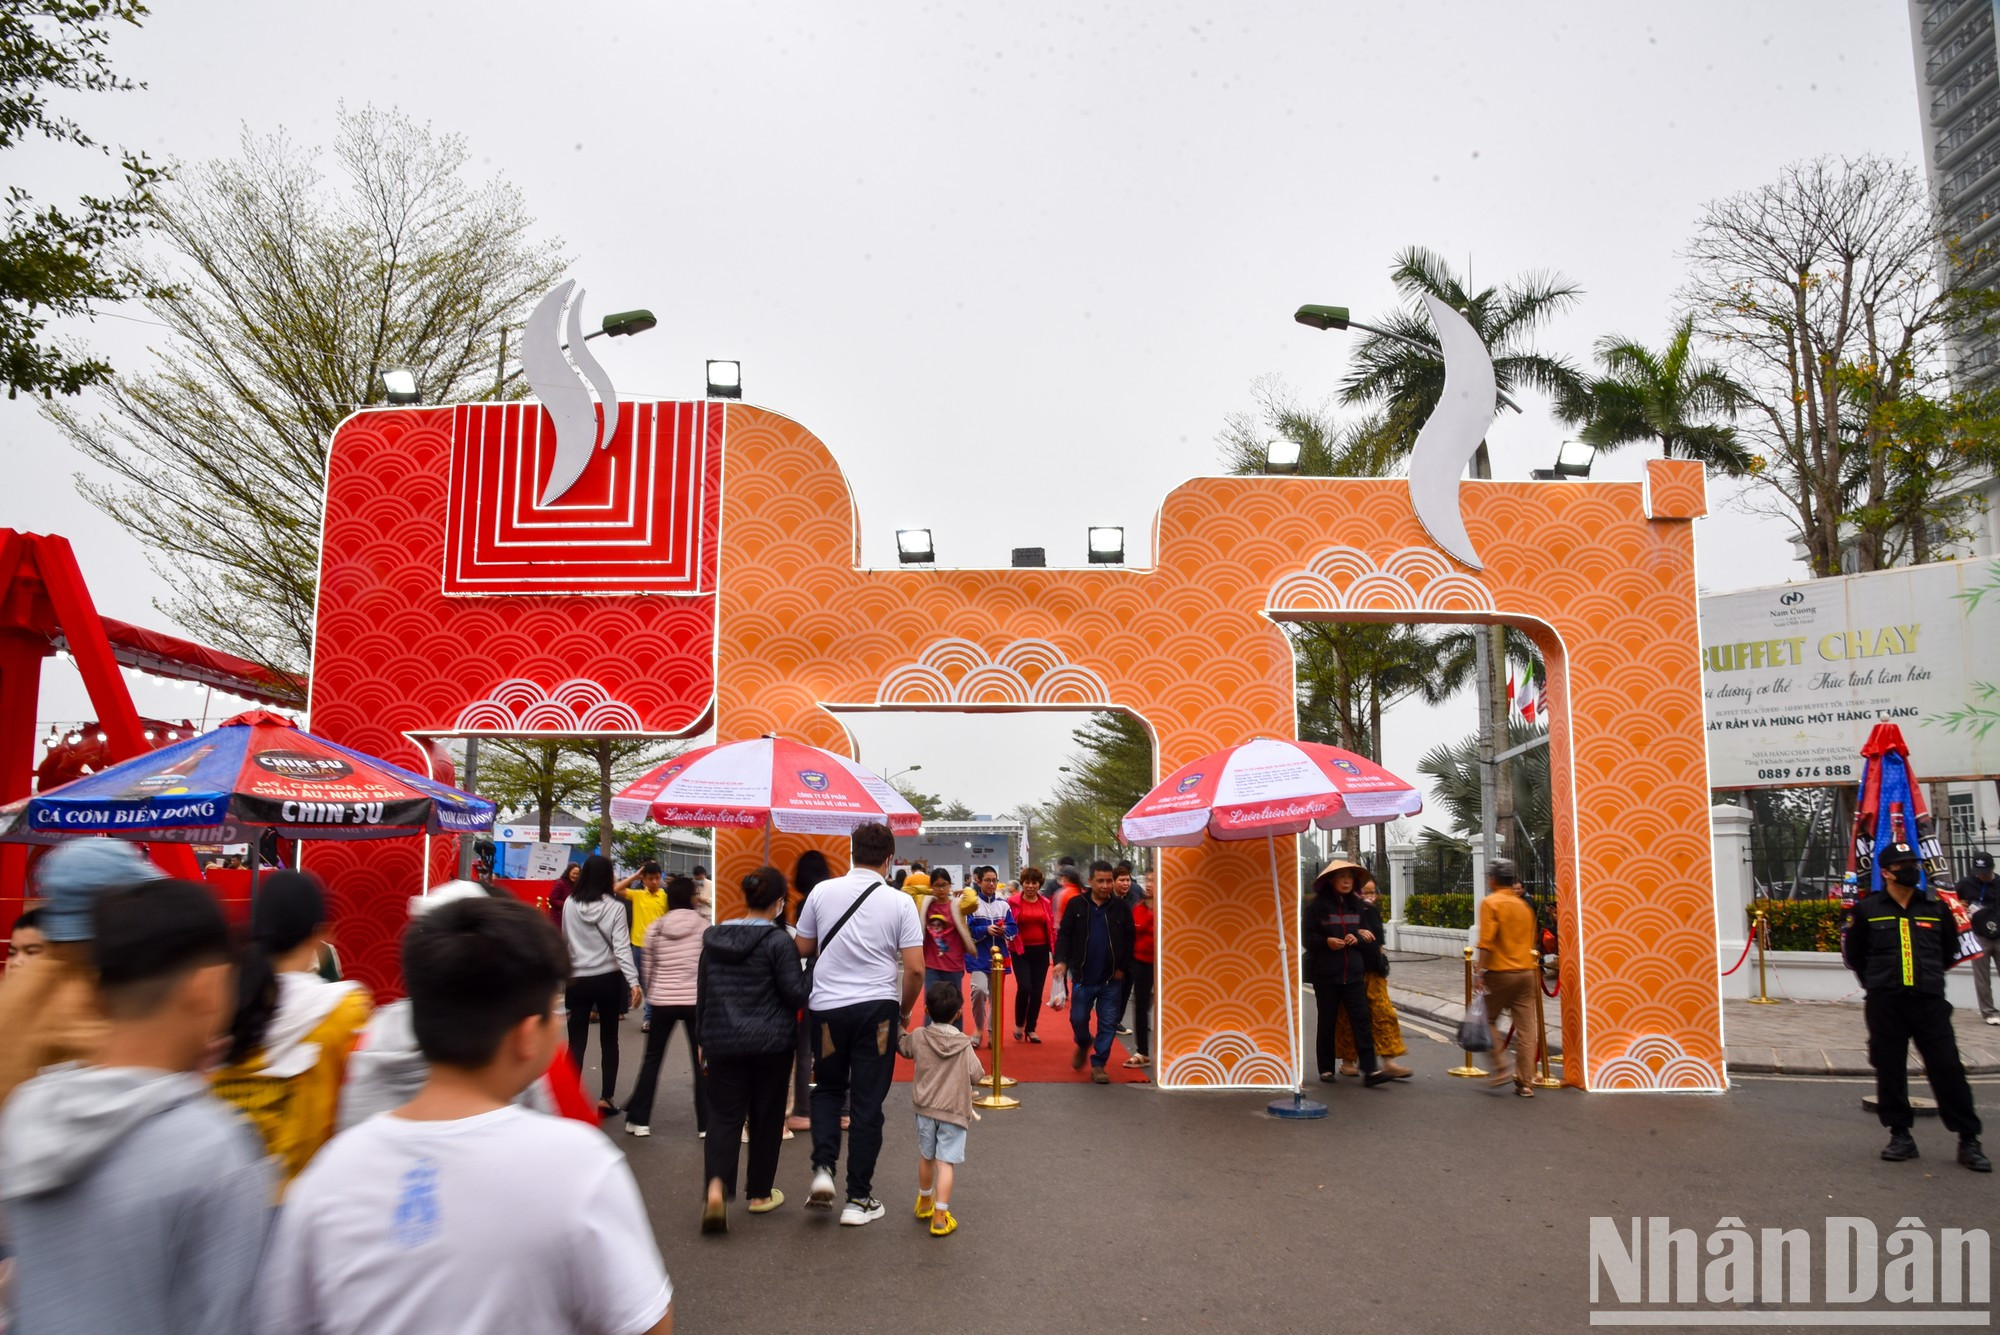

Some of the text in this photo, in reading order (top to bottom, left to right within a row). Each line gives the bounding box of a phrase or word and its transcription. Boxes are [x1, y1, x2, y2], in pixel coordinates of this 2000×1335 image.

[1818, 623, 1922, 662] CHAY
[1837, 709, 1872, 721] HÀNG
[259, 757, 343, 769] CHIN-SU
[1758, 764, 1852, 780] 0889 676 888
[38, 807, 61, 823] CÁ
[281, 800, 384, 825] CHIN-SU
[1901, 920, 1912, 983] SECURITY
